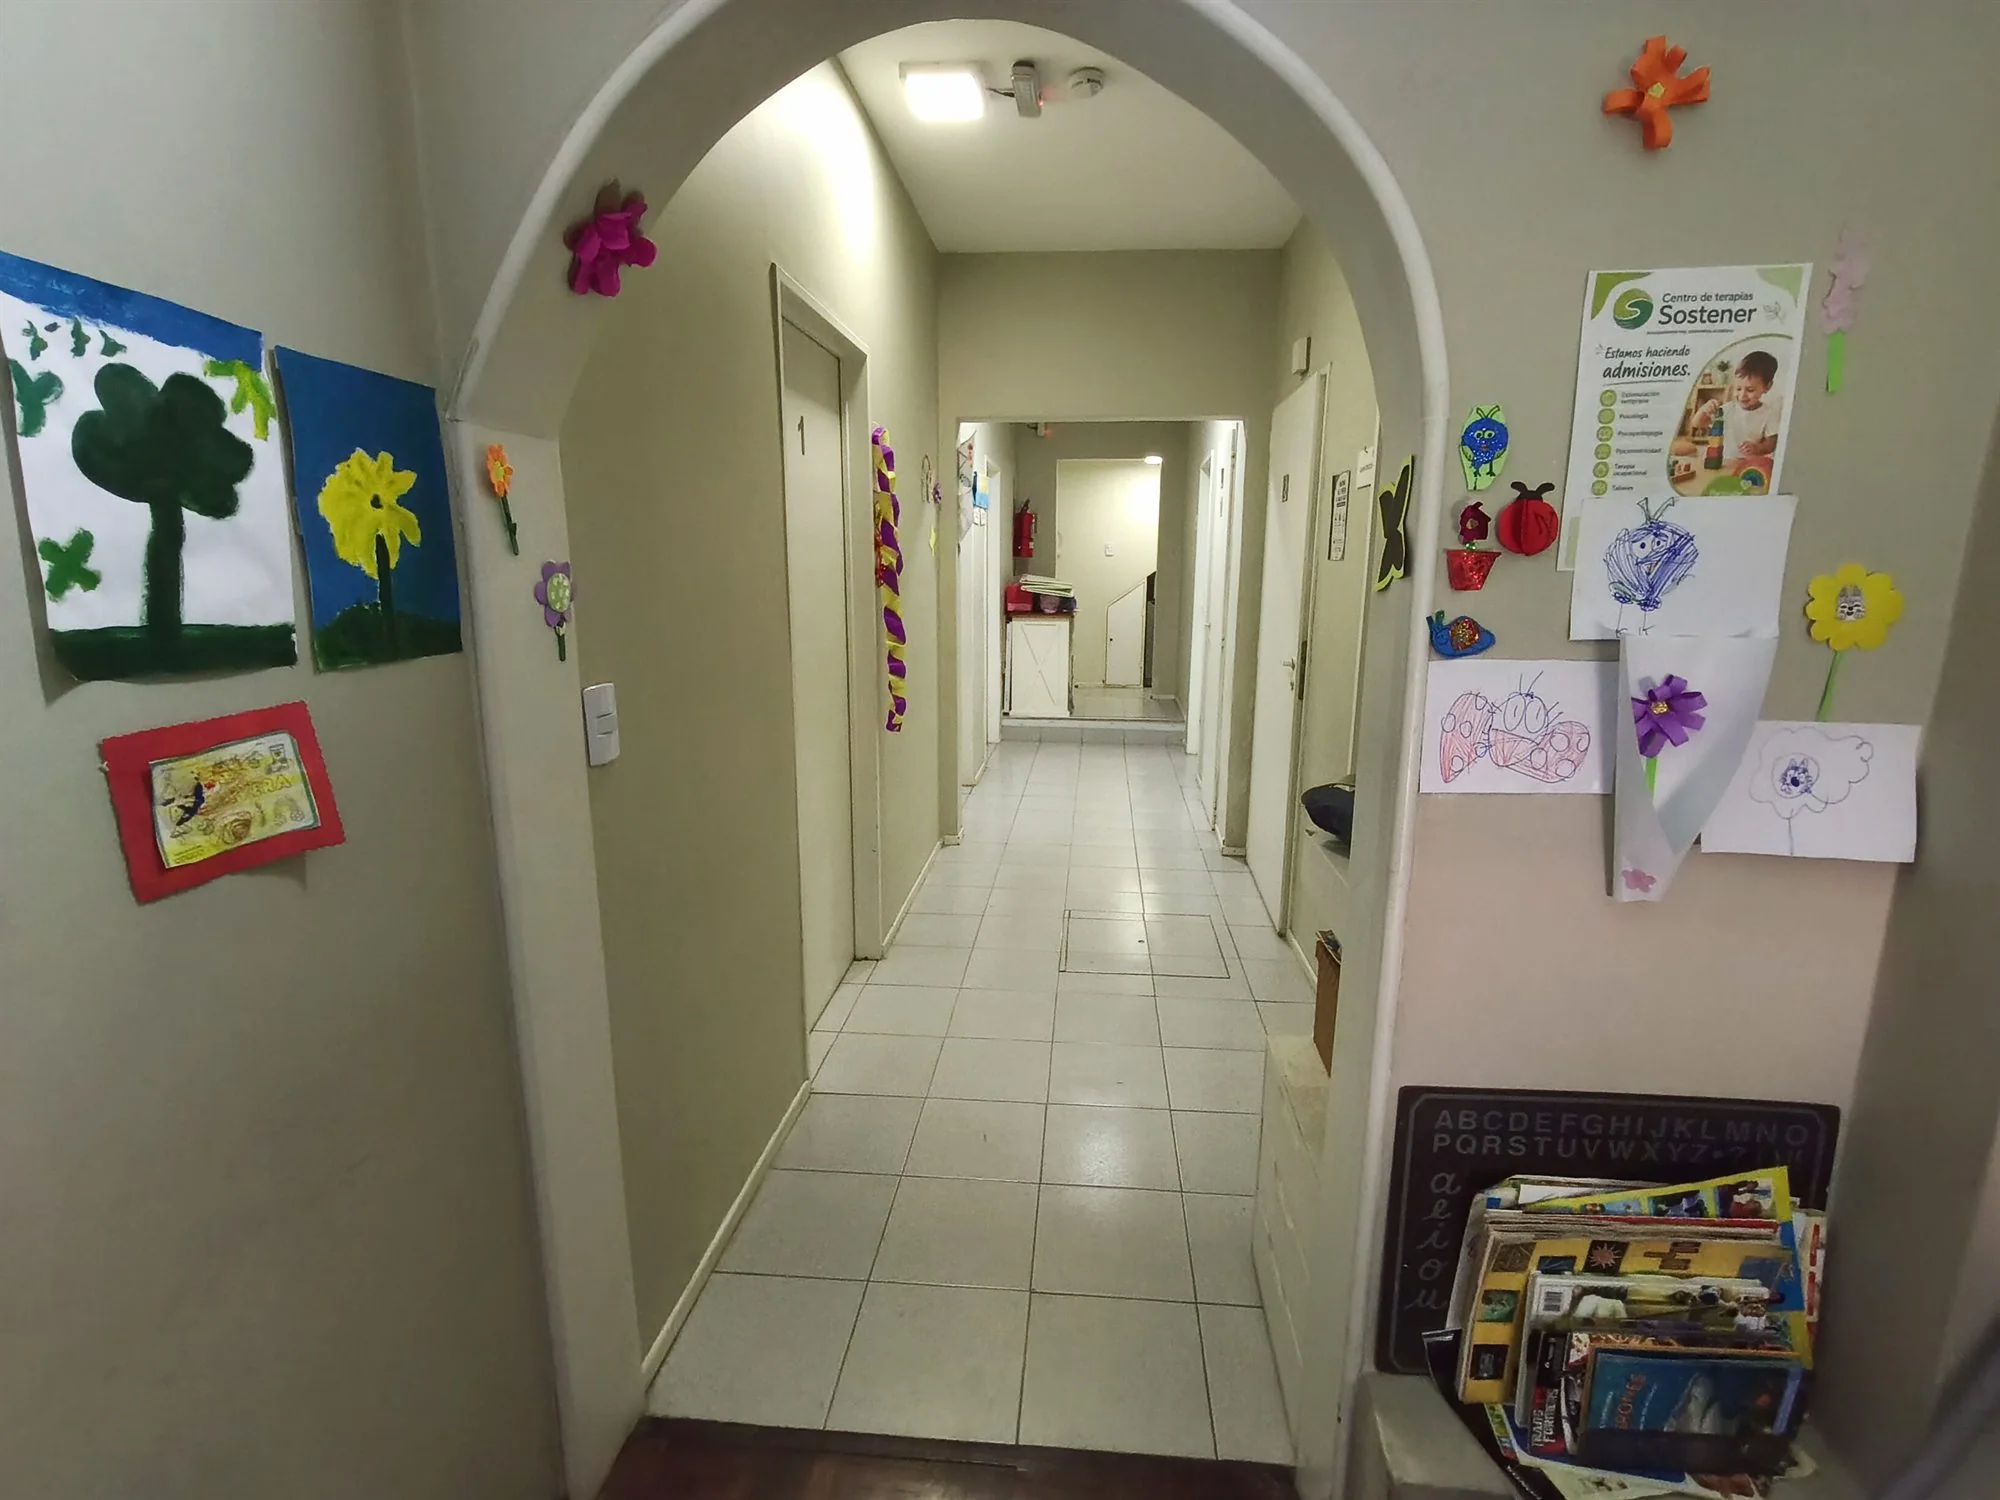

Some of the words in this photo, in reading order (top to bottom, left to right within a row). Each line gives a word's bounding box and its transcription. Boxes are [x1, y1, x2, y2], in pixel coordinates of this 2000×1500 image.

[1662, 292, 1697, 304] Centro
[1700, 291, 1713, 302] de
[1715, 291, 1754, 304] terapias
[1658, 304, 1757, 326] Sostener
[1604, 346, 1642, 359] Estamos
[1646, 344, 1691, 358] haciendo
[1602, 360, 1691, 379] admisiones.
[798, 416, 805, 455] 1
[1430, 1172, 1462, 1195] a
[1415, 1222, 1449, 1250] i
